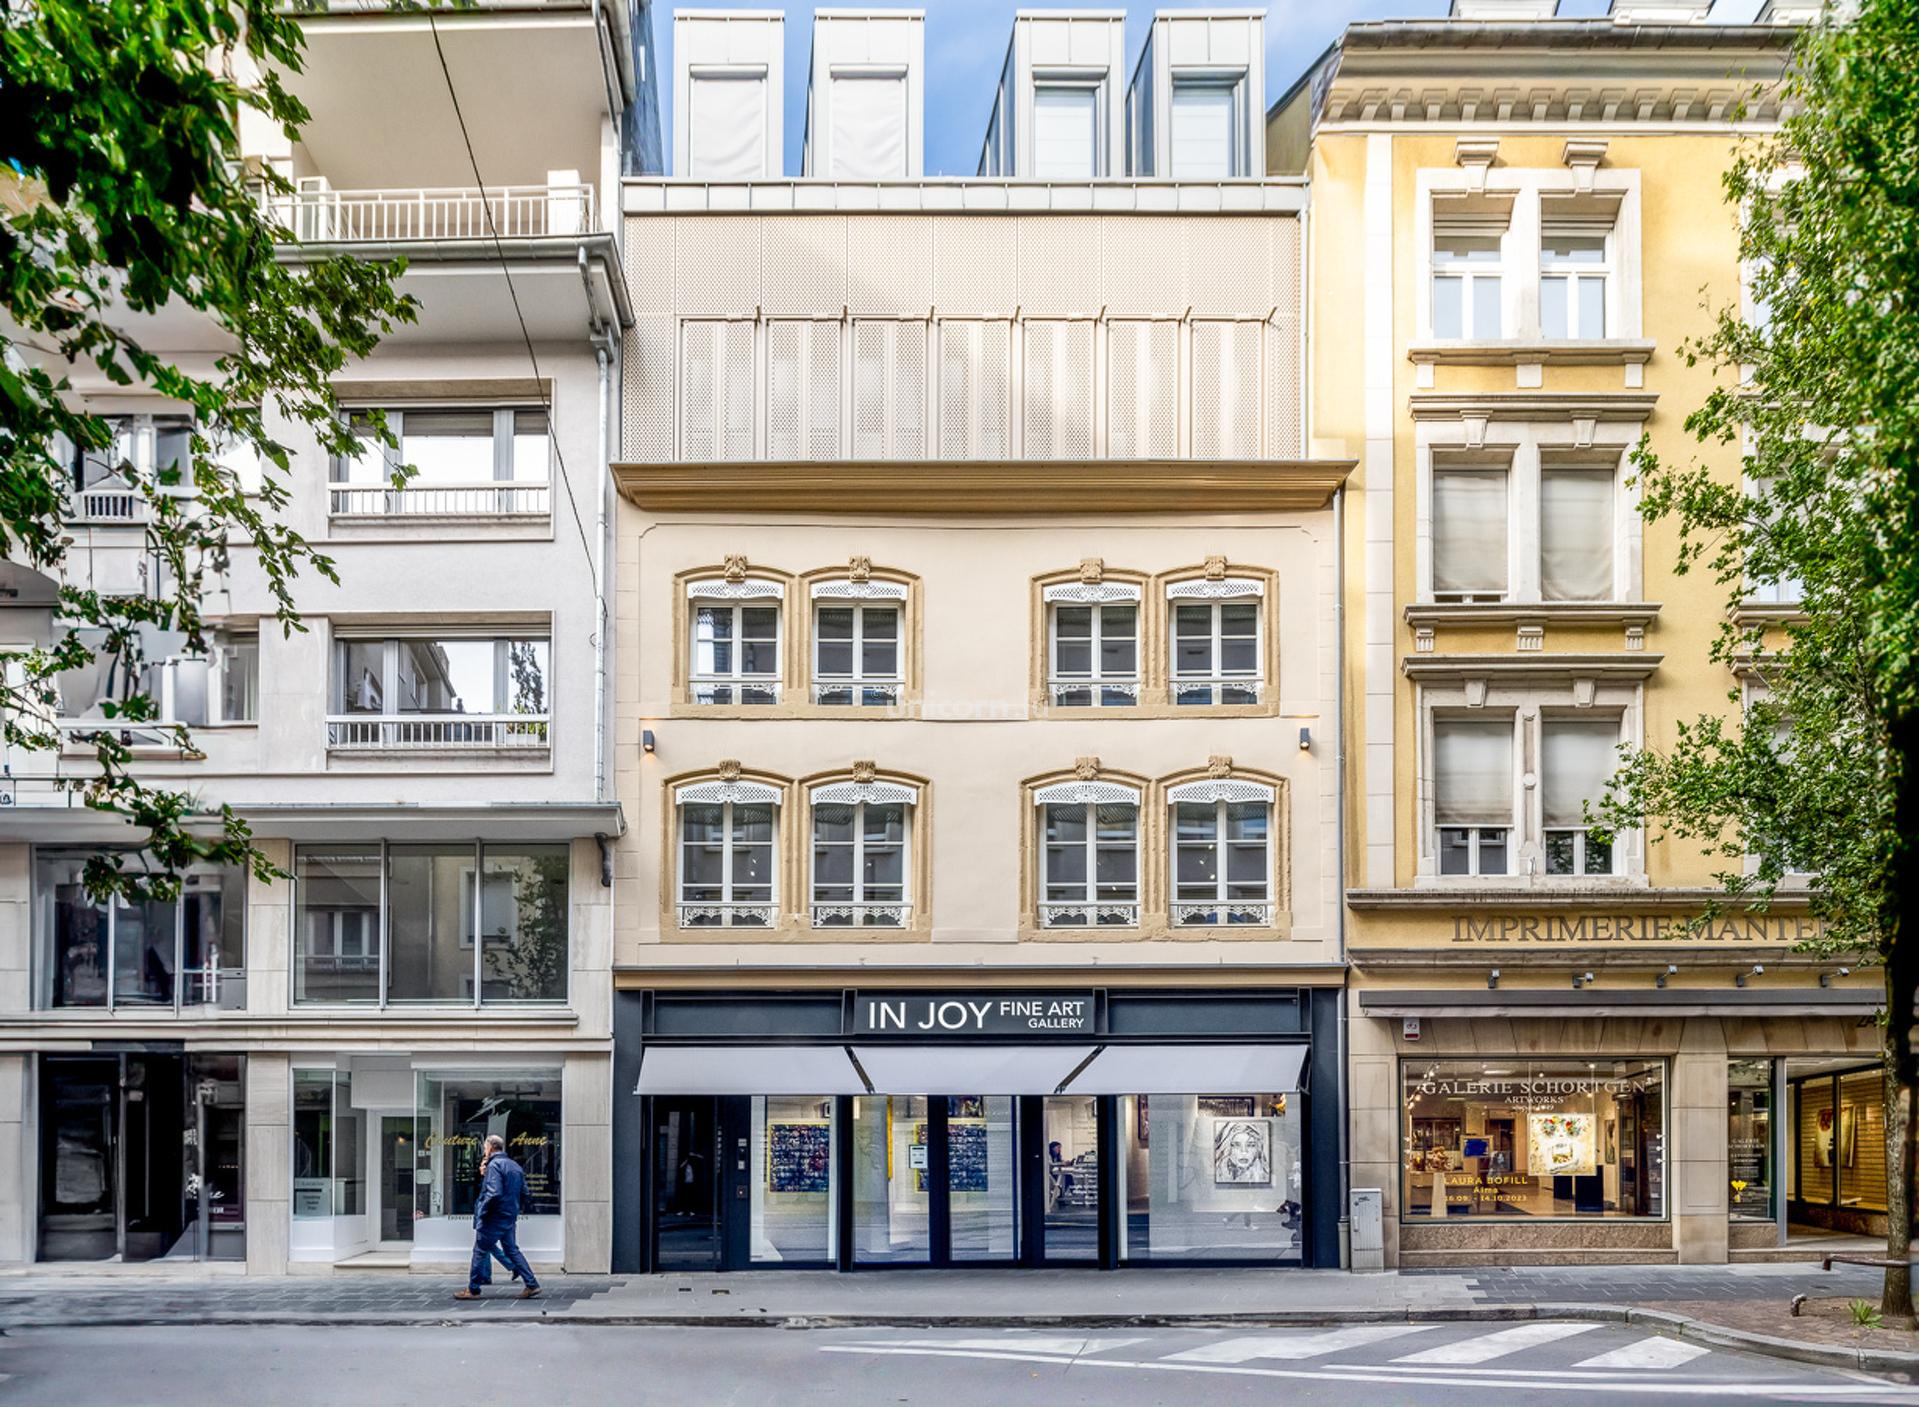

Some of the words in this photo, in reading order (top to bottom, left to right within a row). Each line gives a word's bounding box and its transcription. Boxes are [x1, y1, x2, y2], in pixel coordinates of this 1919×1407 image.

[1452, 915, 1673, 942] IMPRIMERIE
[869, 1002, 906, 1029] IN
[918, 1002, 992, 1029] JOY
[1000, 1002, 1043, 1016] FINE
[1047, 1002, 1085, 1016] ART
[1028, 1018, 1085, 1028] GALLERY
[1422, 1080, 1513, 1095] GALERIE
[1520, 1080, 1648, 1095] SCHORTGEN
[1504, 1095, 1564, 1105] ARTWORKS
[424, 1132, 480, 1151] Couture
[508, 1131, 549, 1147] Anne
[1443, 1176, 1483, 1185] LAURA
[1487, 1176, 1529, 1185] BOFILL
[1473, 1186, 1499, 1194] Alma
